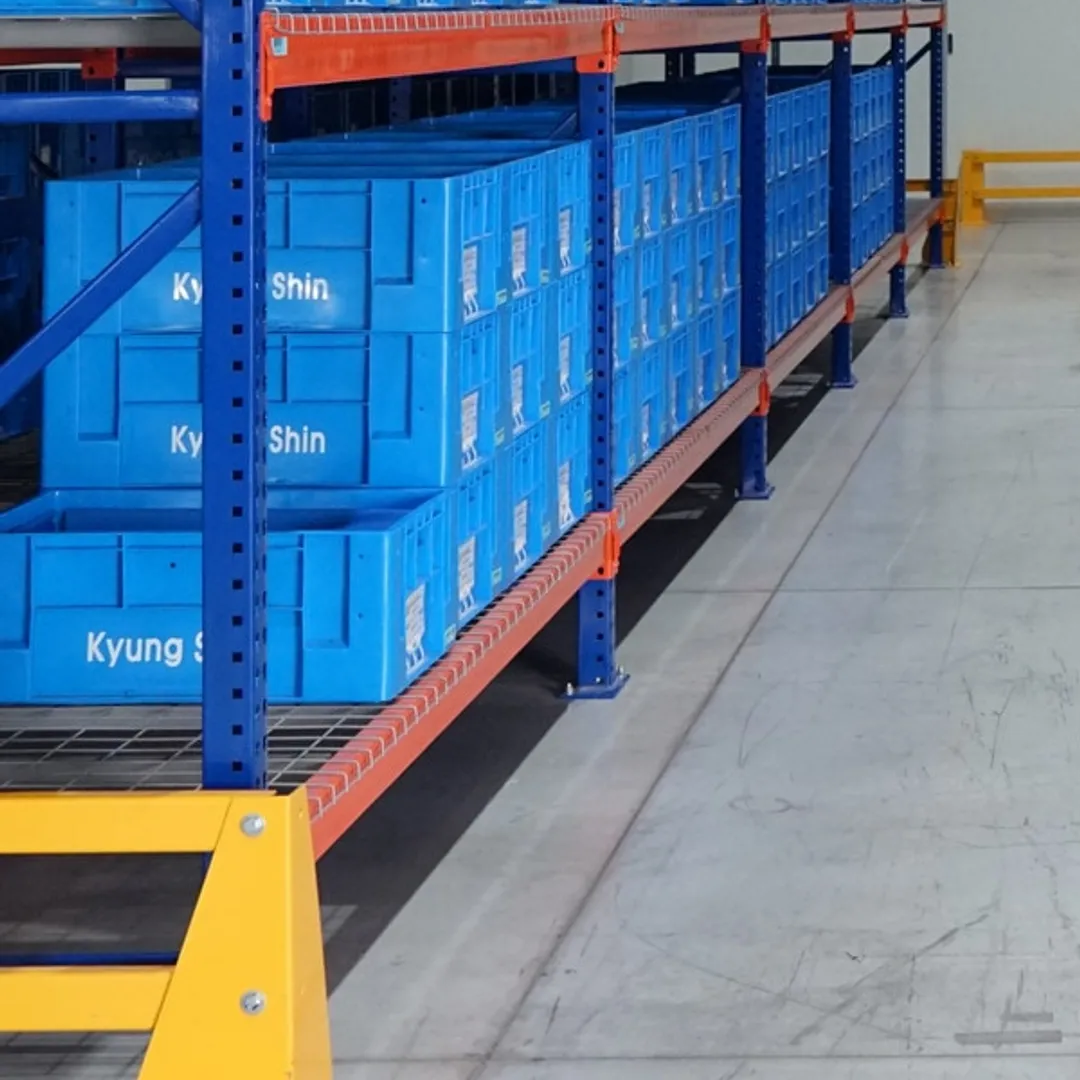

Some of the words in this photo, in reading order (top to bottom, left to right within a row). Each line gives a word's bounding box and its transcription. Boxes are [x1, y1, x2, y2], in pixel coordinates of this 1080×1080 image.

[272, 271, 329, 301] Shin
[269, 424, 325, 454] Shin
[87, 631, 183, 668] Kyung
